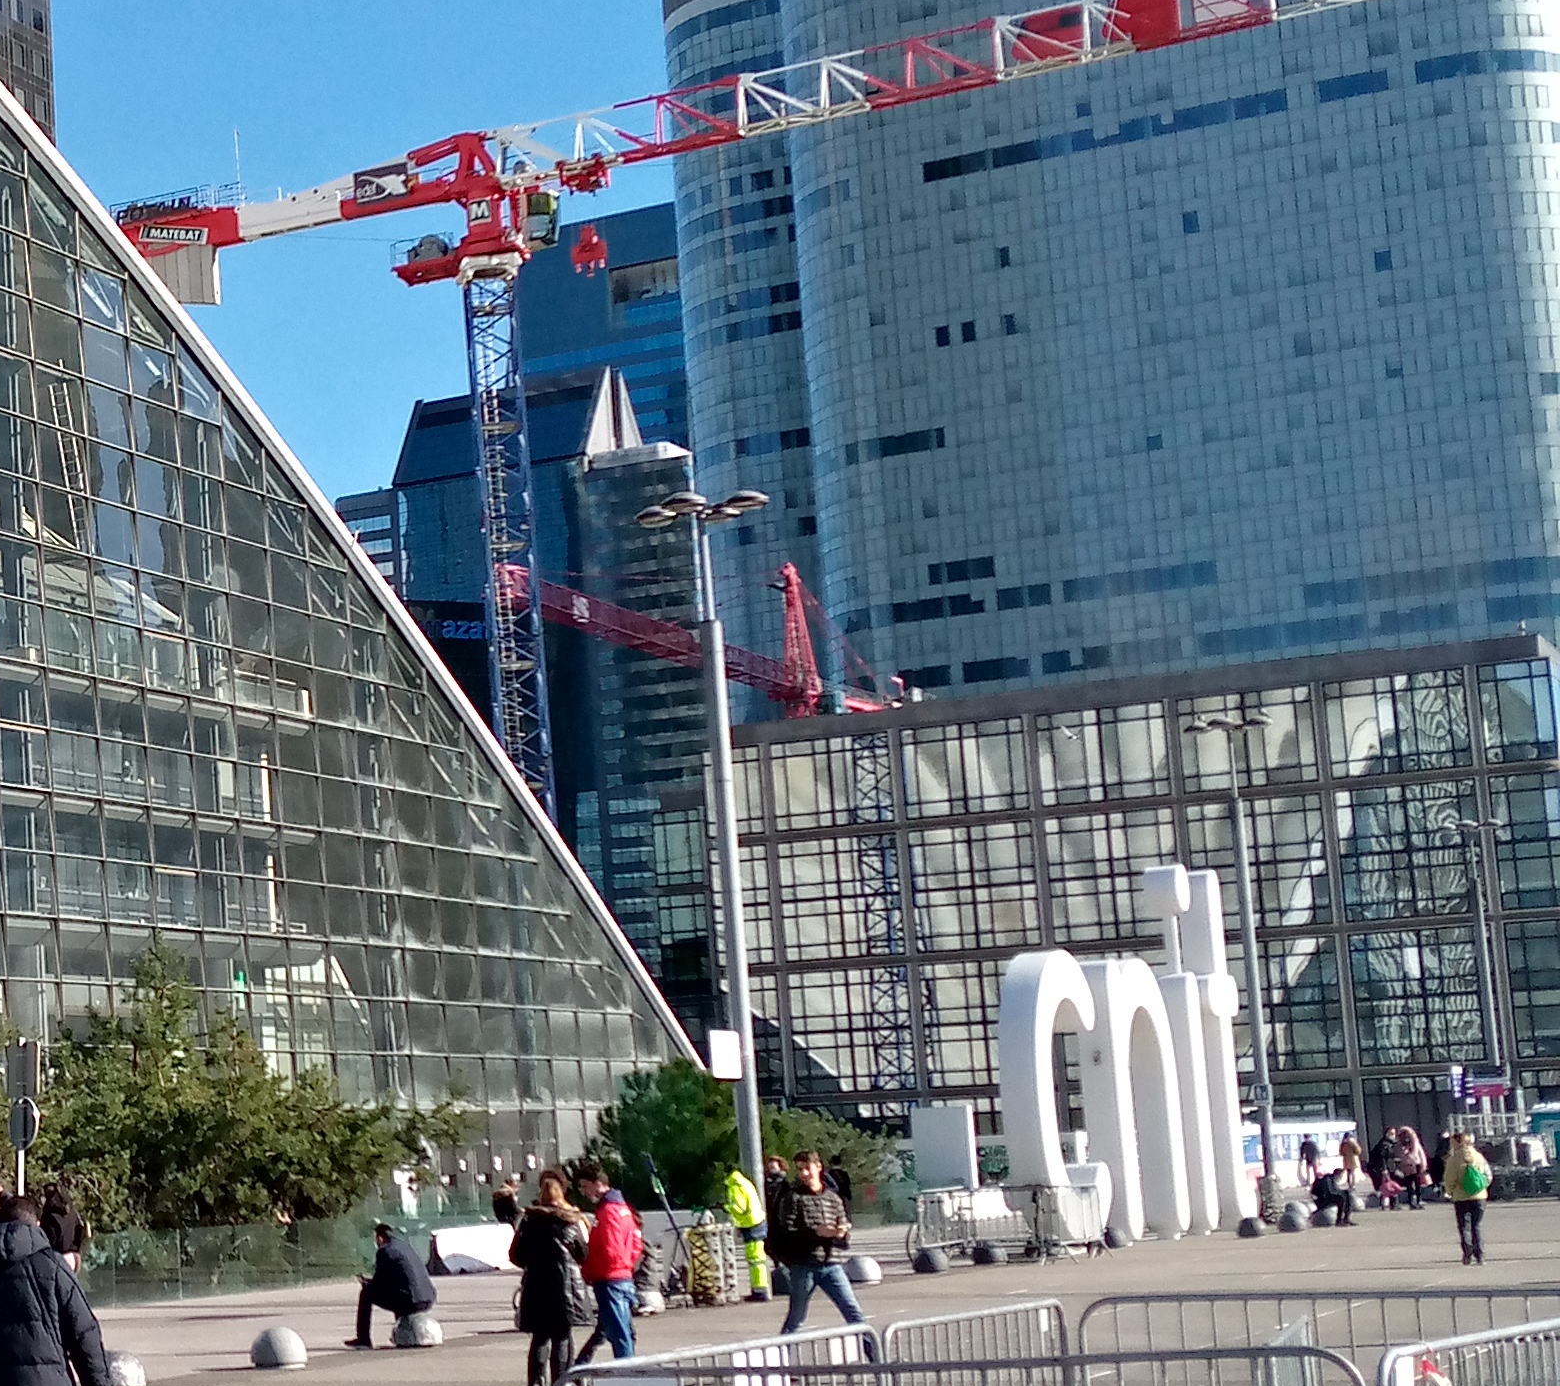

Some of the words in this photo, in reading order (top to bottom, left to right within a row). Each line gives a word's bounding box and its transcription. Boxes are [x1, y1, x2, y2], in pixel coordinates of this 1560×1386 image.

[470, 201, 489, 218] M
[149, 228, 201, 241] MATEBAT
[999, 864, 1258, 1241] cnit
